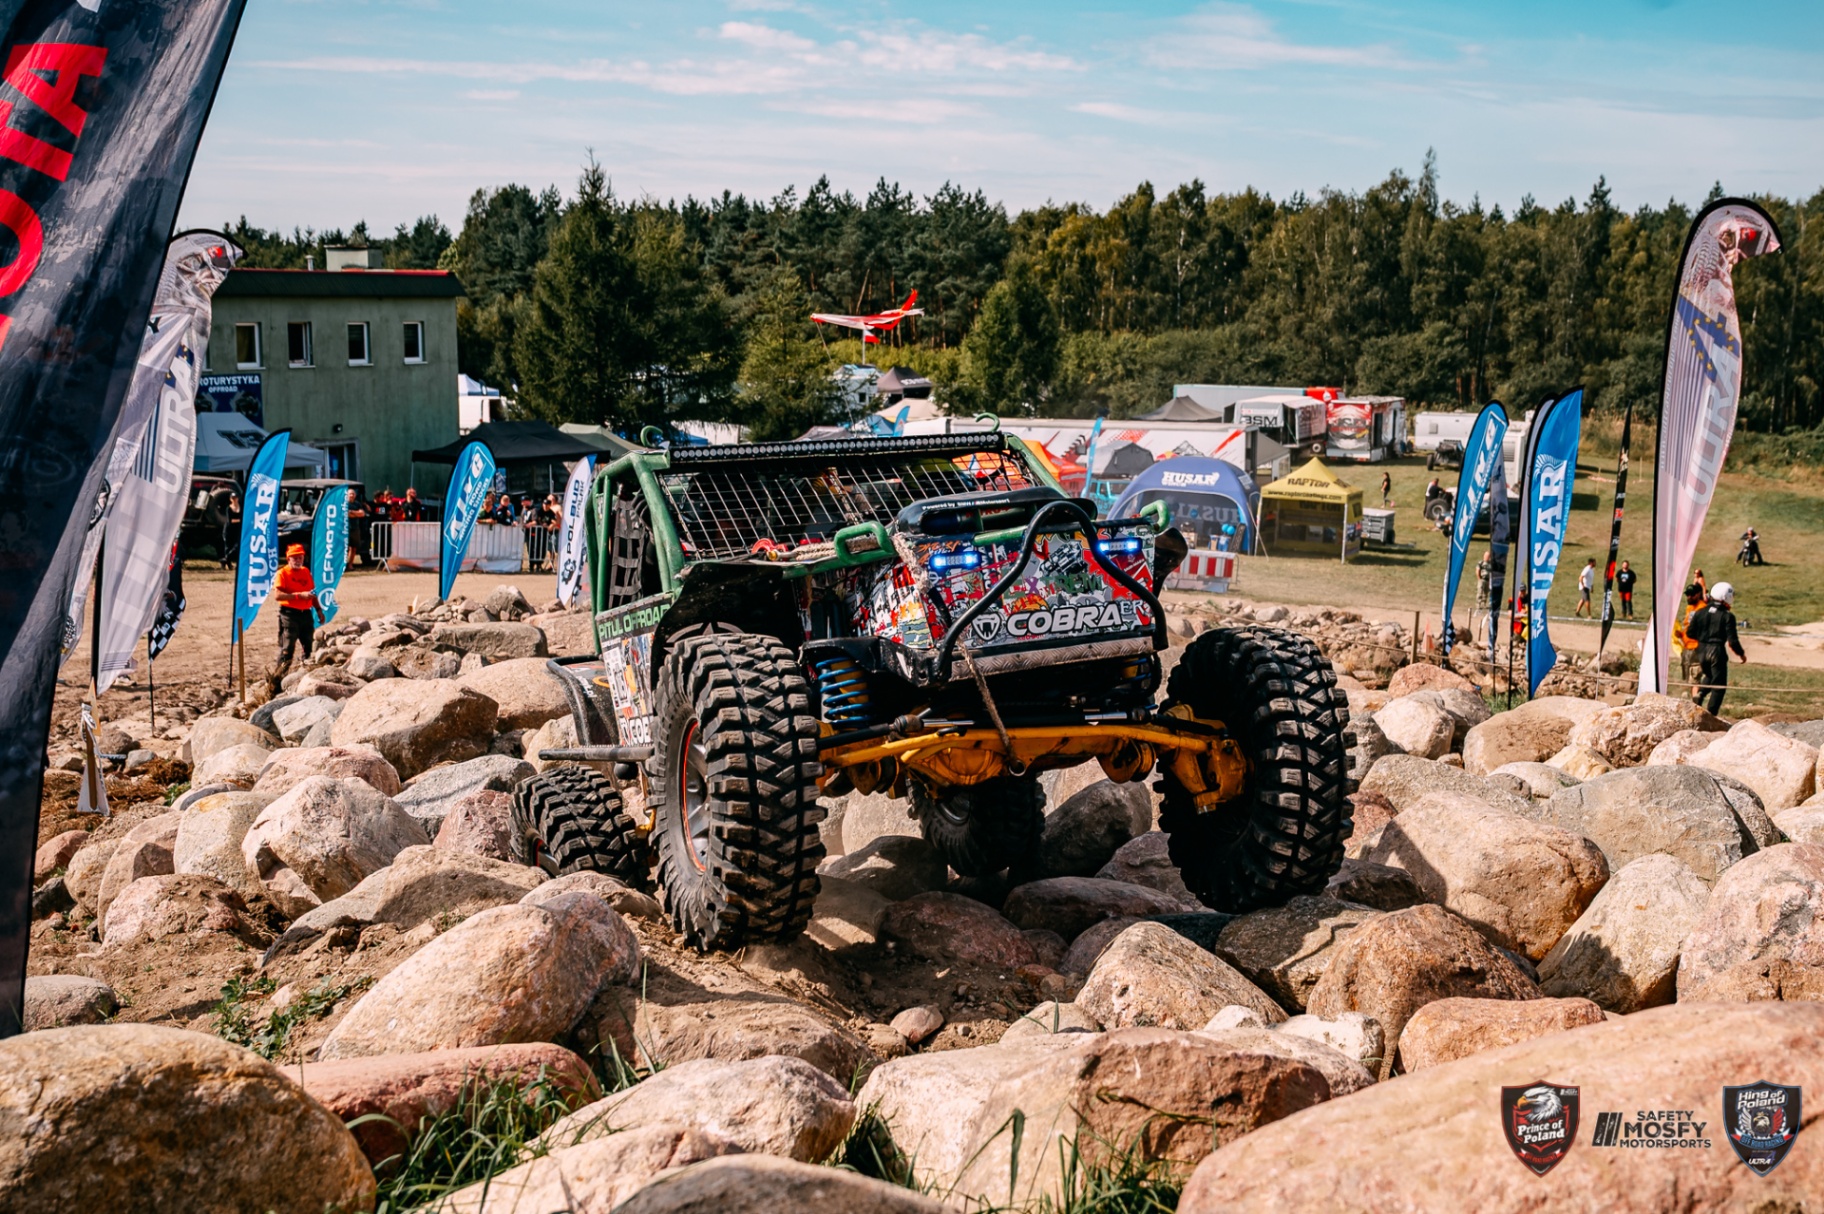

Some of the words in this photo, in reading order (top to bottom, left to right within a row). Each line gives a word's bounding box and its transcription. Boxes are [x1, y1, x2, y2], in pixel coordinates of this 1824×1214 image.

[1163, 471, 1216, 486] HUSAR
[1287, 477, 1331, 489] RAPTOR
[566, 479, 580, 555] POLBUD
[247, 479, 278, 609] HUSAR
[322, 504, 337, 585] CFMOTO
[599, 618, 624, 639] PITUL
[1007, 603, 1122, 636] COBRA
